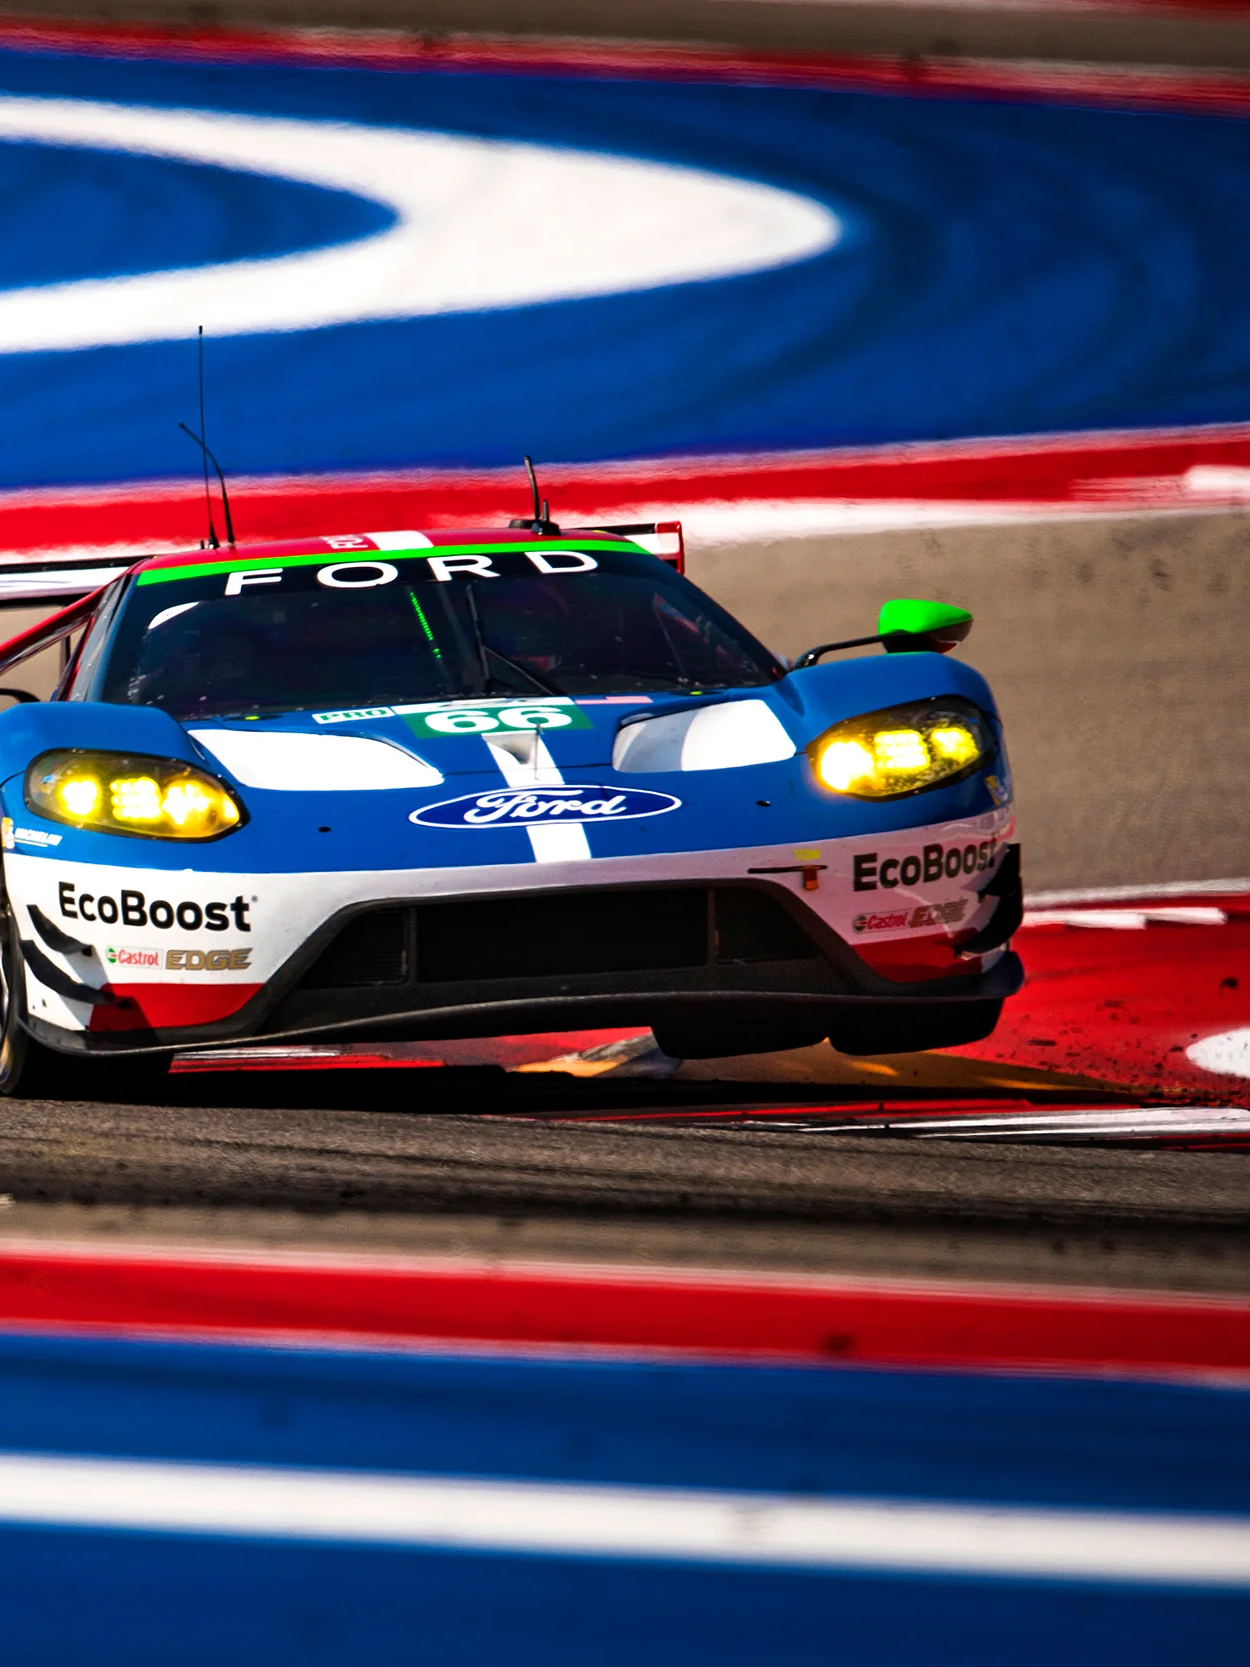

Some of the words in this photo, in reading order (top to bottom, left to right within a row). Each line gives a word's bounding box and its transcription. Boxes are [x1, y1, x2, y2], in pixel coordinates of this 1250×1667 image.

[224, 551, 599, 596] FORD
[319, 709, 387, 721] PRO
[424, 706, 573, 733] 66
[463, 789, 627, 824] Ford
[853, 832, 996, 892] EcoBoost
[117, 949, 160, 967] Castrol
[165, 947, 254, 971] EDGE
